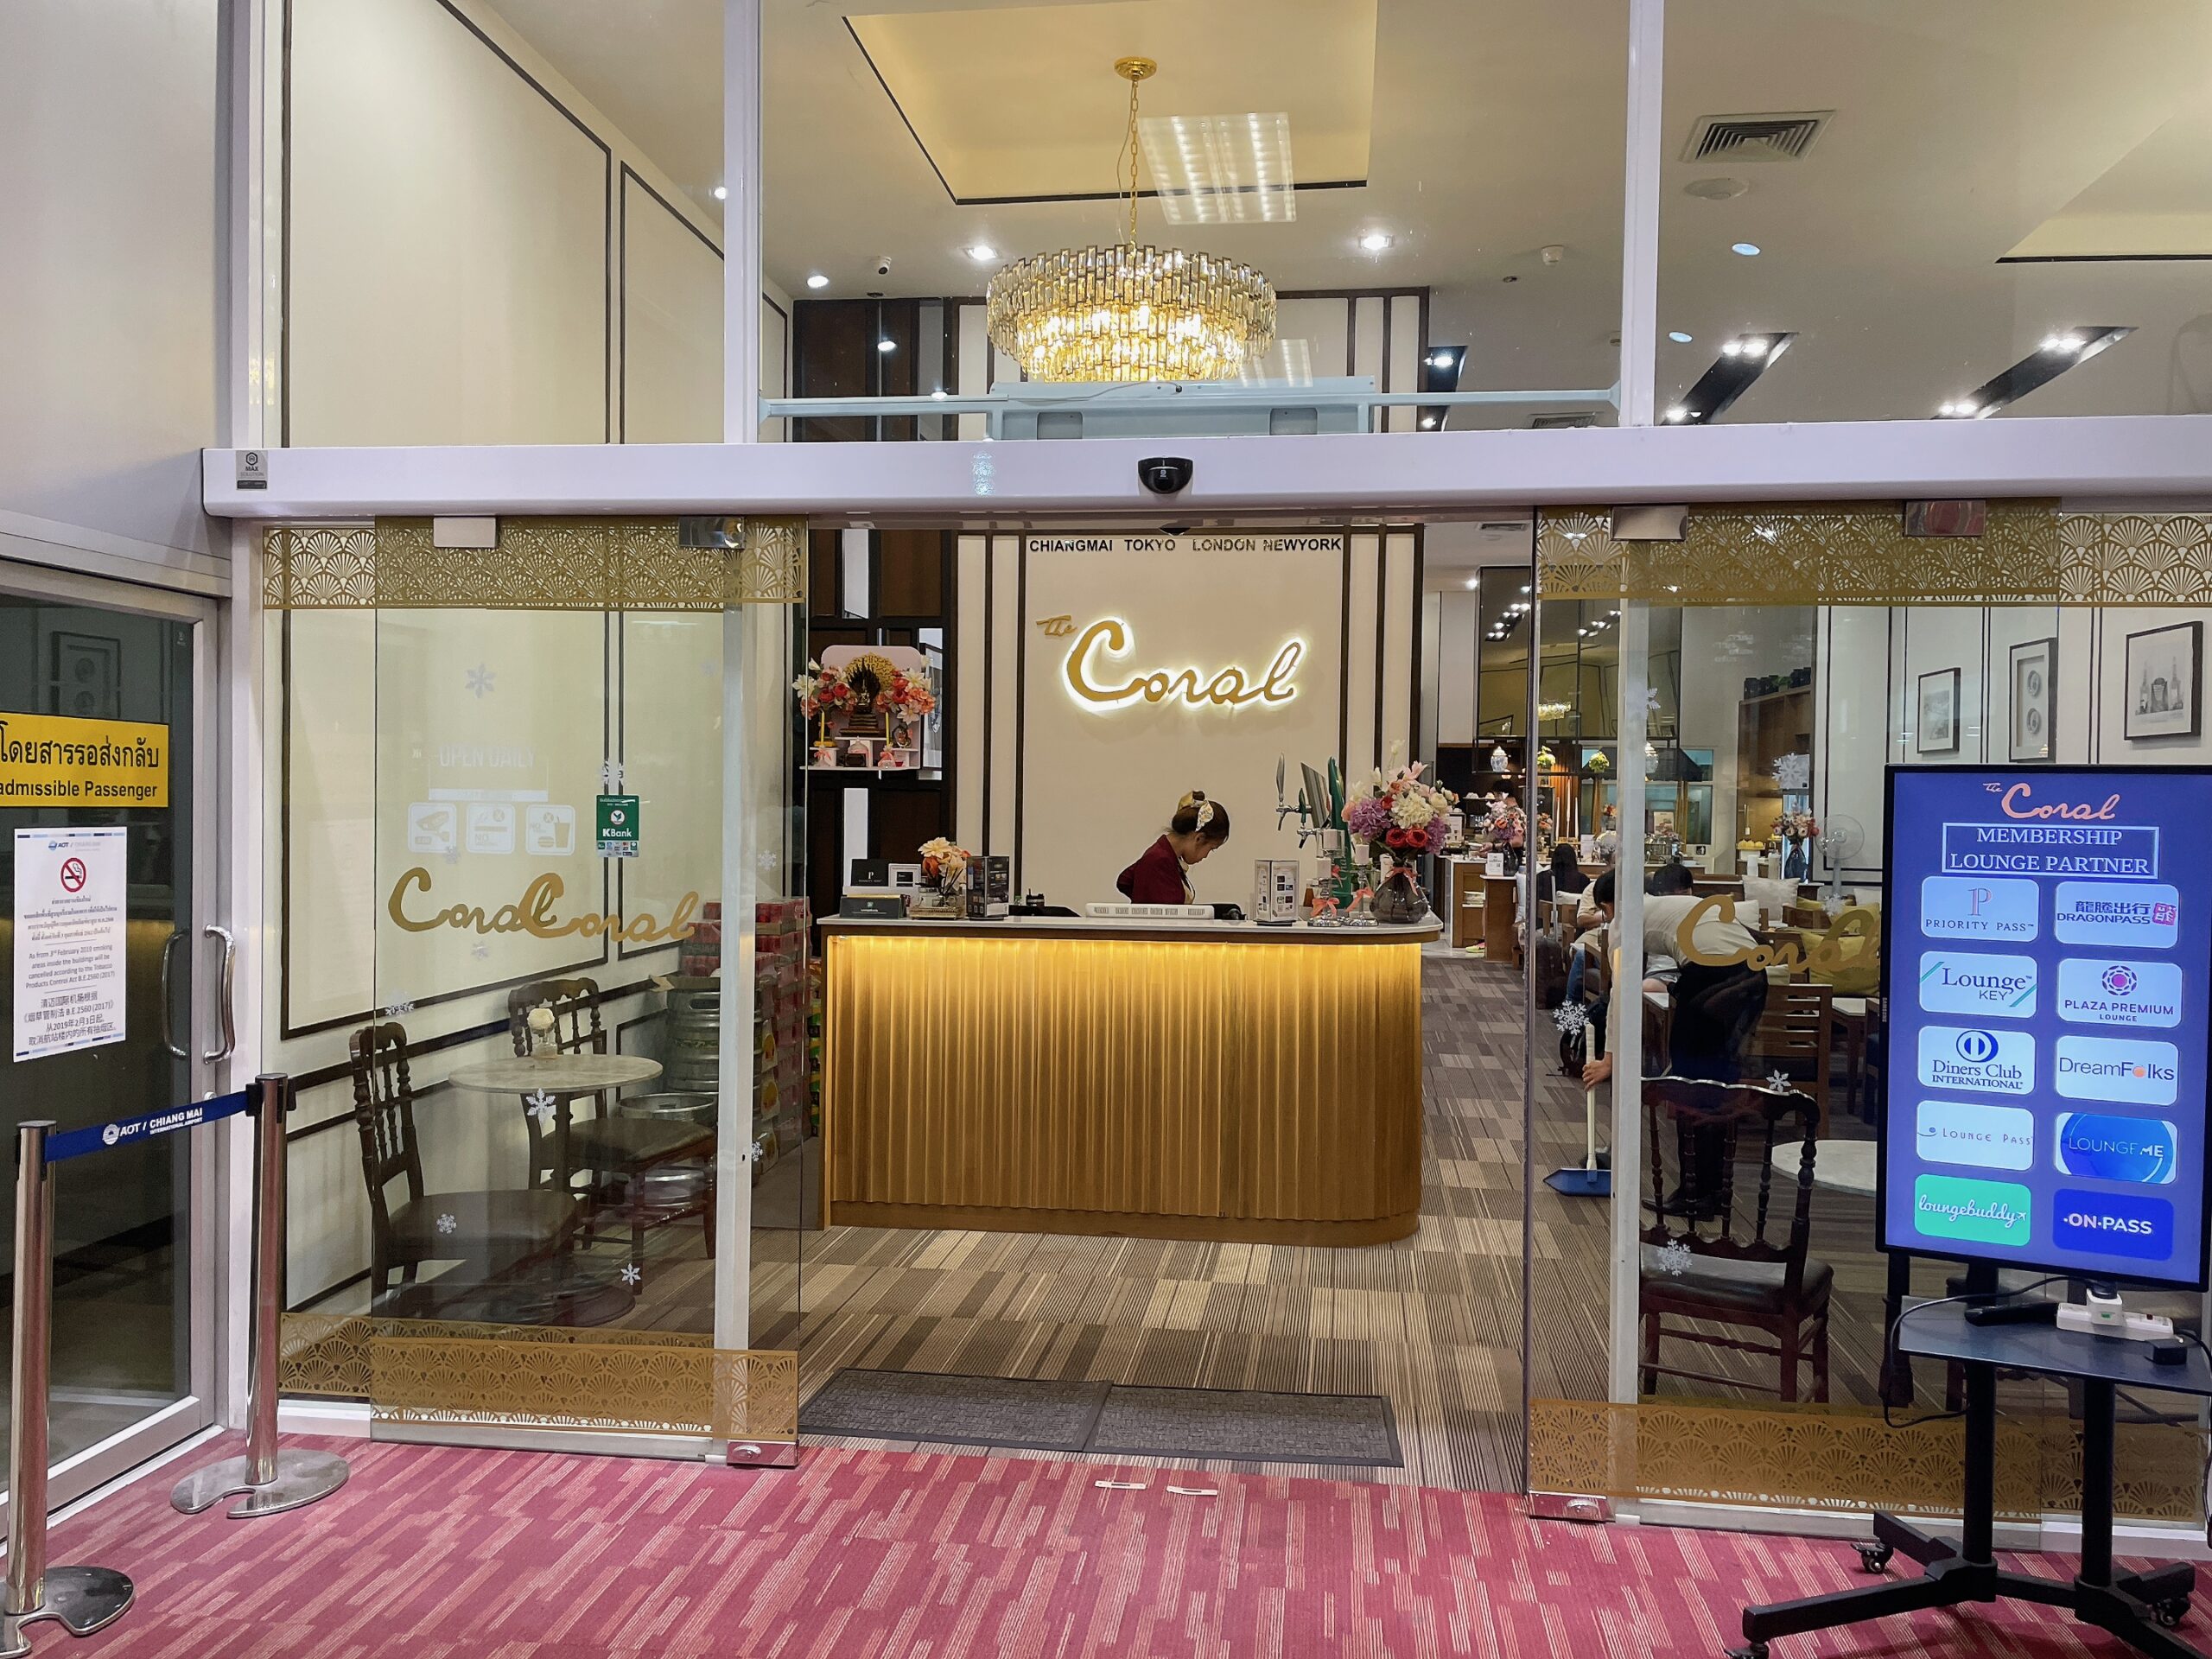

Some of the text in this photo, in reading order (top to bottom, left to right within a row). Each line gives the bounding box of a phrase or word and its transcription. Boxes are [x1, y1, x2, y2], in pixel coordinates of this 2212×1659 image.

[1029, 539, 1113, 552] CHIANGMAI
[1124, 539, 1176, 551] TOKYO
[1192, 538, 1255, 551] LONDON
[1066, 620, 1302, 705] Coral
[85, 781, 157, 800] Passenger
[1982, 782, 2120, 820] The Coral
[602, 828, 632, 837] KBank
[1976, 828, 2122, 846] MEMBERSHIP
[1950, 854, 2150, 874] LOUNGE PARTNER
[519, 873, 699, 942] Coral
[1926, 918, 1989, 930] PRIORITY
[2057, 913, 2151, 925] DRAGONPASS
[1942, 967, 2026, 995] Lounge
[1979, 990, 2008, 1001] KEY
[2064, 1000, 2174, 1014] PLAZA PREMIUM
[1932, 1058, 2022, 1079] Diners Club
[1932, 1074, 2023, 1090] INTERNATIONAL
[119, 1122, 142, 1137] AOT
[149, 1112, 185, 1128] CHIANG
[186, 1108, 203, 1120] MAI
[1942, 1128, 1992, 1141] LOUNGE
[1918, 1194, 2017, 1228] loungebuddy
